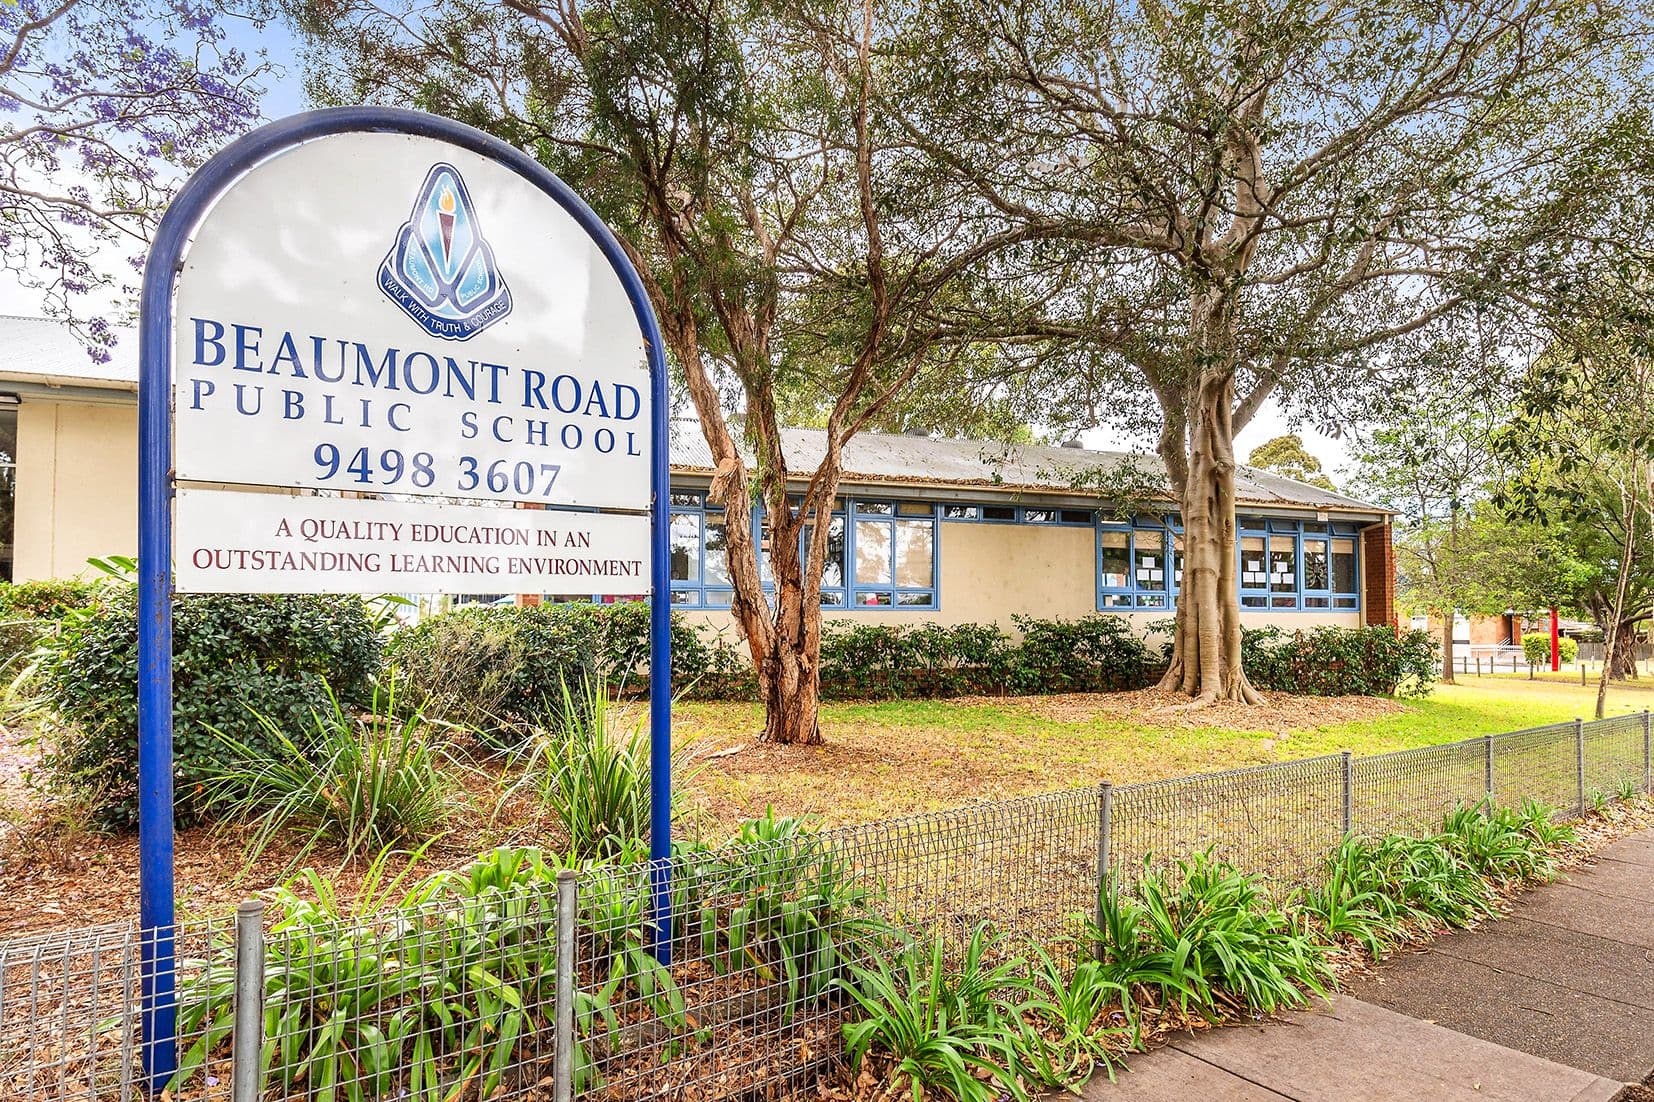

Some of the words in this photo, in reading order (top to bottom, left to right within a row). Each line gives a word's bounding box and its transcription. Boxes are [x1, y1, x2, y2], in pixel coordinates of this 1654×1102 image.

[383, 277, 408, 303] WALK
[407, 301, 429, 323] WITH
[430, 318, 462, 334] TRUTH
[463, 320, 472, 332] &
[472, 300, 507, 328] COURAGE
[190, 317, 508, 404] BEAUMONT
[522, 369, 641, 420] ROAD
[190, 378, 411, 432] PUBLIC
[462, 411, 641, 456] SCHOOL
[314, 444, 435, 488] 9498
[458, 456, 560, 496] 3607
[276, 518, 292, 536] A
[300, 518, 402, 543] QUALITY
[412, 524, 529, 546] EDUCATION
[537, 529, 558, 547] IN
[564, 531, 591, 548] AN
[193, 549, 380, 573] OUTSTANDING
[391, 554, 499, 574] LEARNING
[508, 557, 642, 577] ENVIRONMENT
